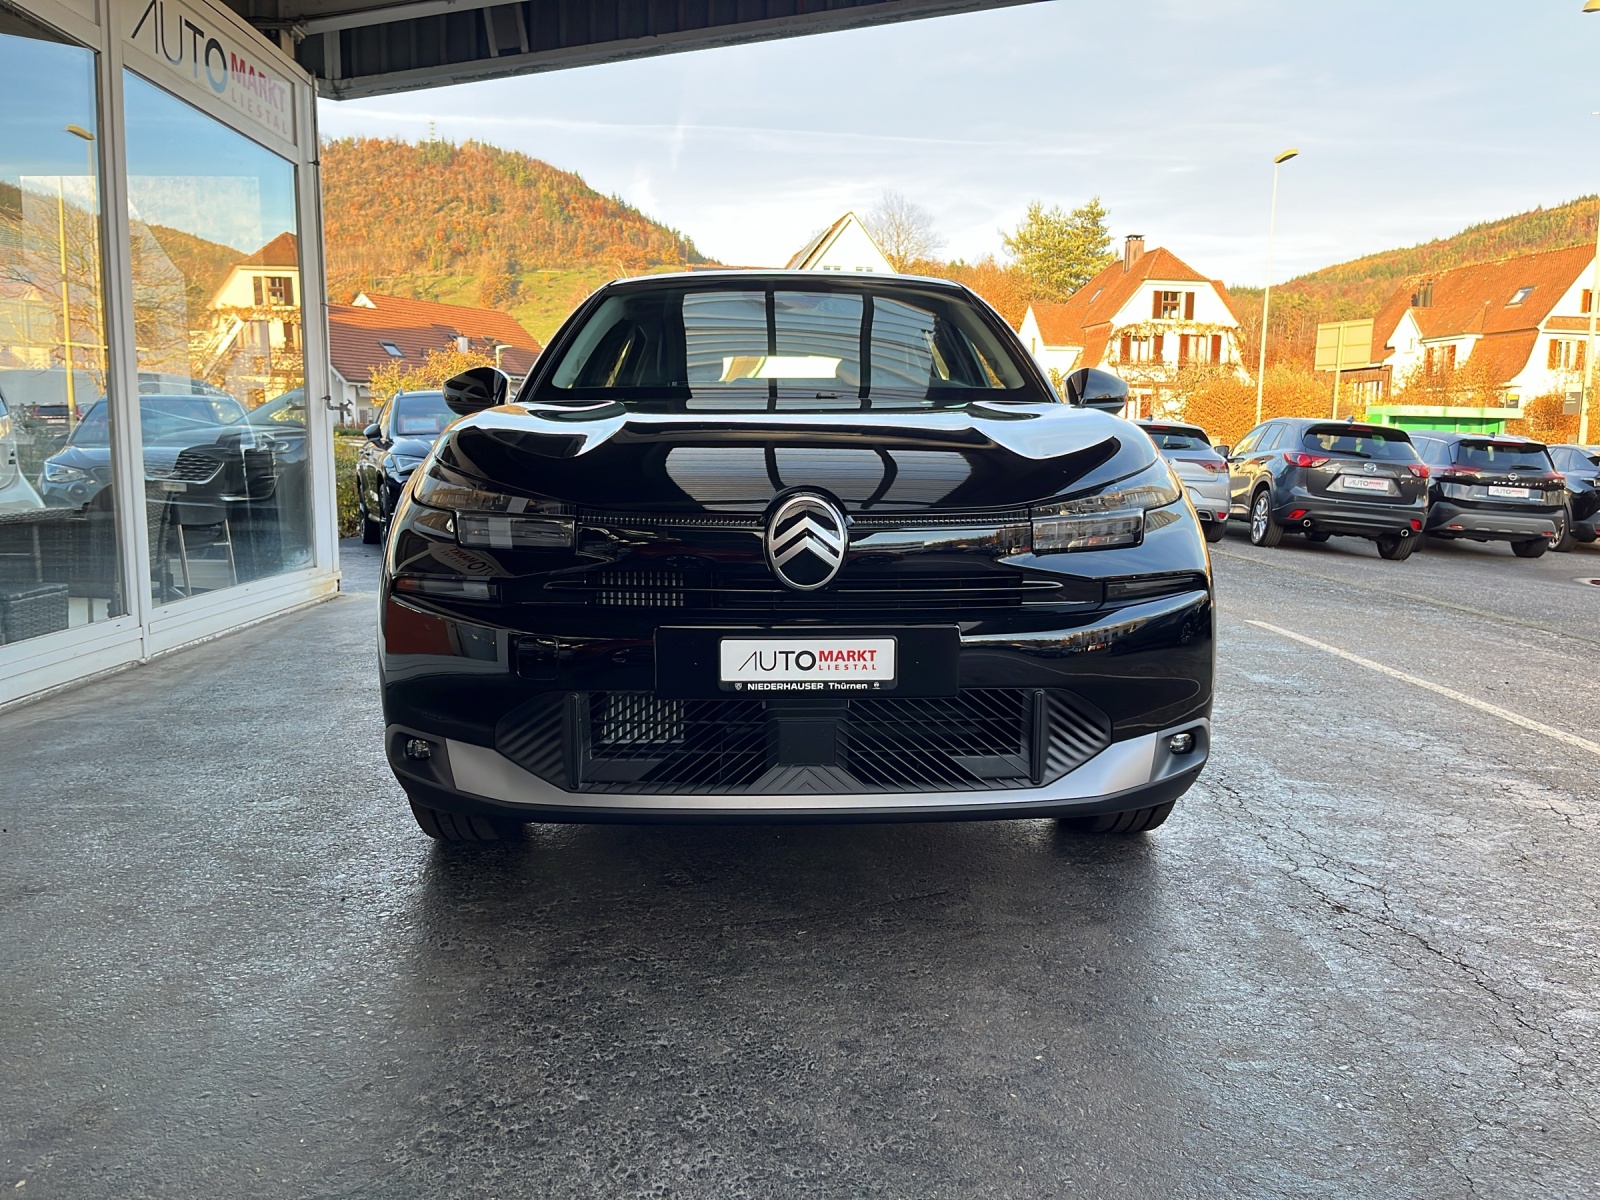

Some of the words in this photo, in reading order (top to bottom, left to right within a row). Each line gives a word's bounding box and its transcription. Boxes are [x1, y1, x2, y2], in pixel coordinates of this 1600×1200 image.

[131, 0, 228, 94] AUTO
[231, 52, 286, 112] MARKT
[231, 88, 287, 134] LIESTAL
[738, 650, 817, 671] AUTO
[819, 650, 877, 662] MARKT
[828, 682, 868, 690] Thürnen
